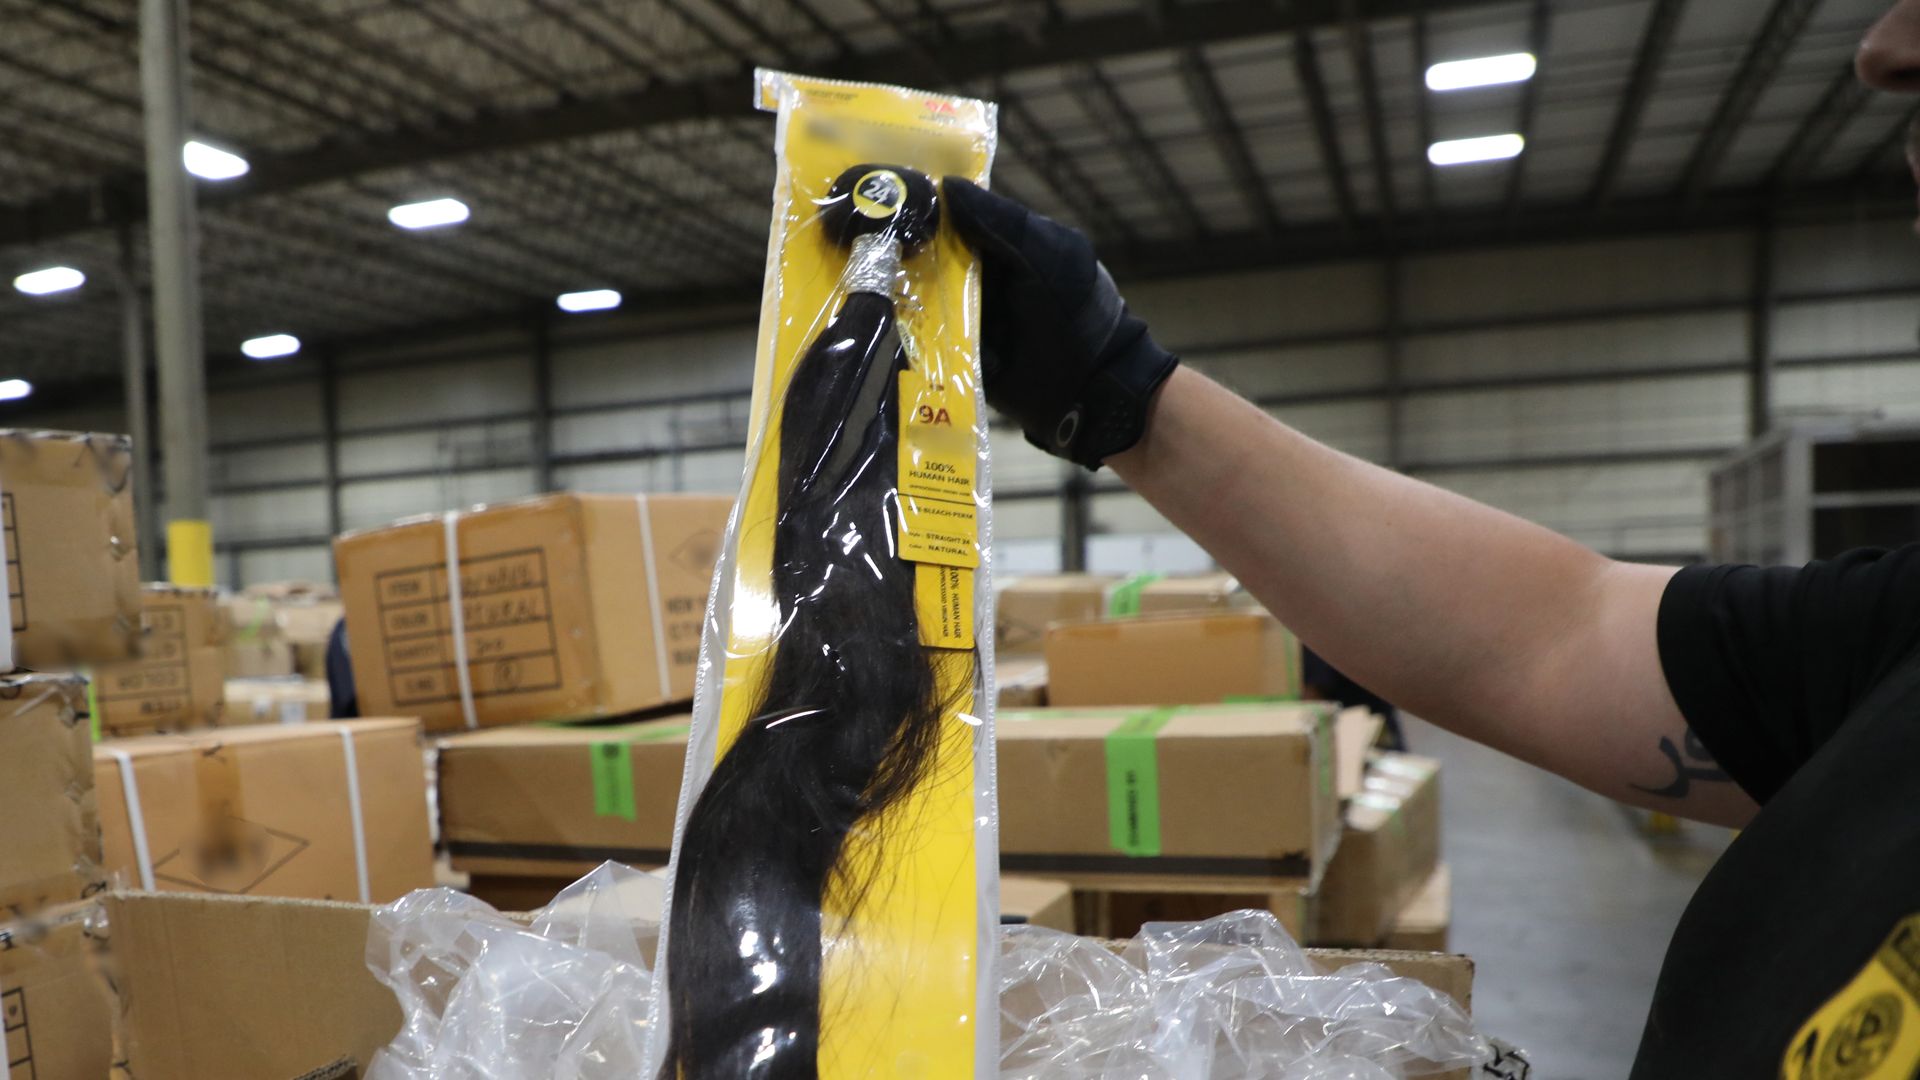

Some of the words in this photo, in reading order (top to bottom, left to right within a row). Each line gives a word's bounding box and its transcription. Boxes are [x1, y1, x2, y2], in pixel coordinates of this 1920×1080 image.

[919, 405, 951, 427] 9A
[925, 461, 955, 474] 100%
[909, 470, 945, 482] HUMAN
[947, 476, 970, 486] HAIR
[926, 533, 961, 543] STRAIGHT
[928, 545, 968, 556] NATURAL
[953, 593, 961, 620] HUMAN
[954, 622, 962, 638] HAIR
